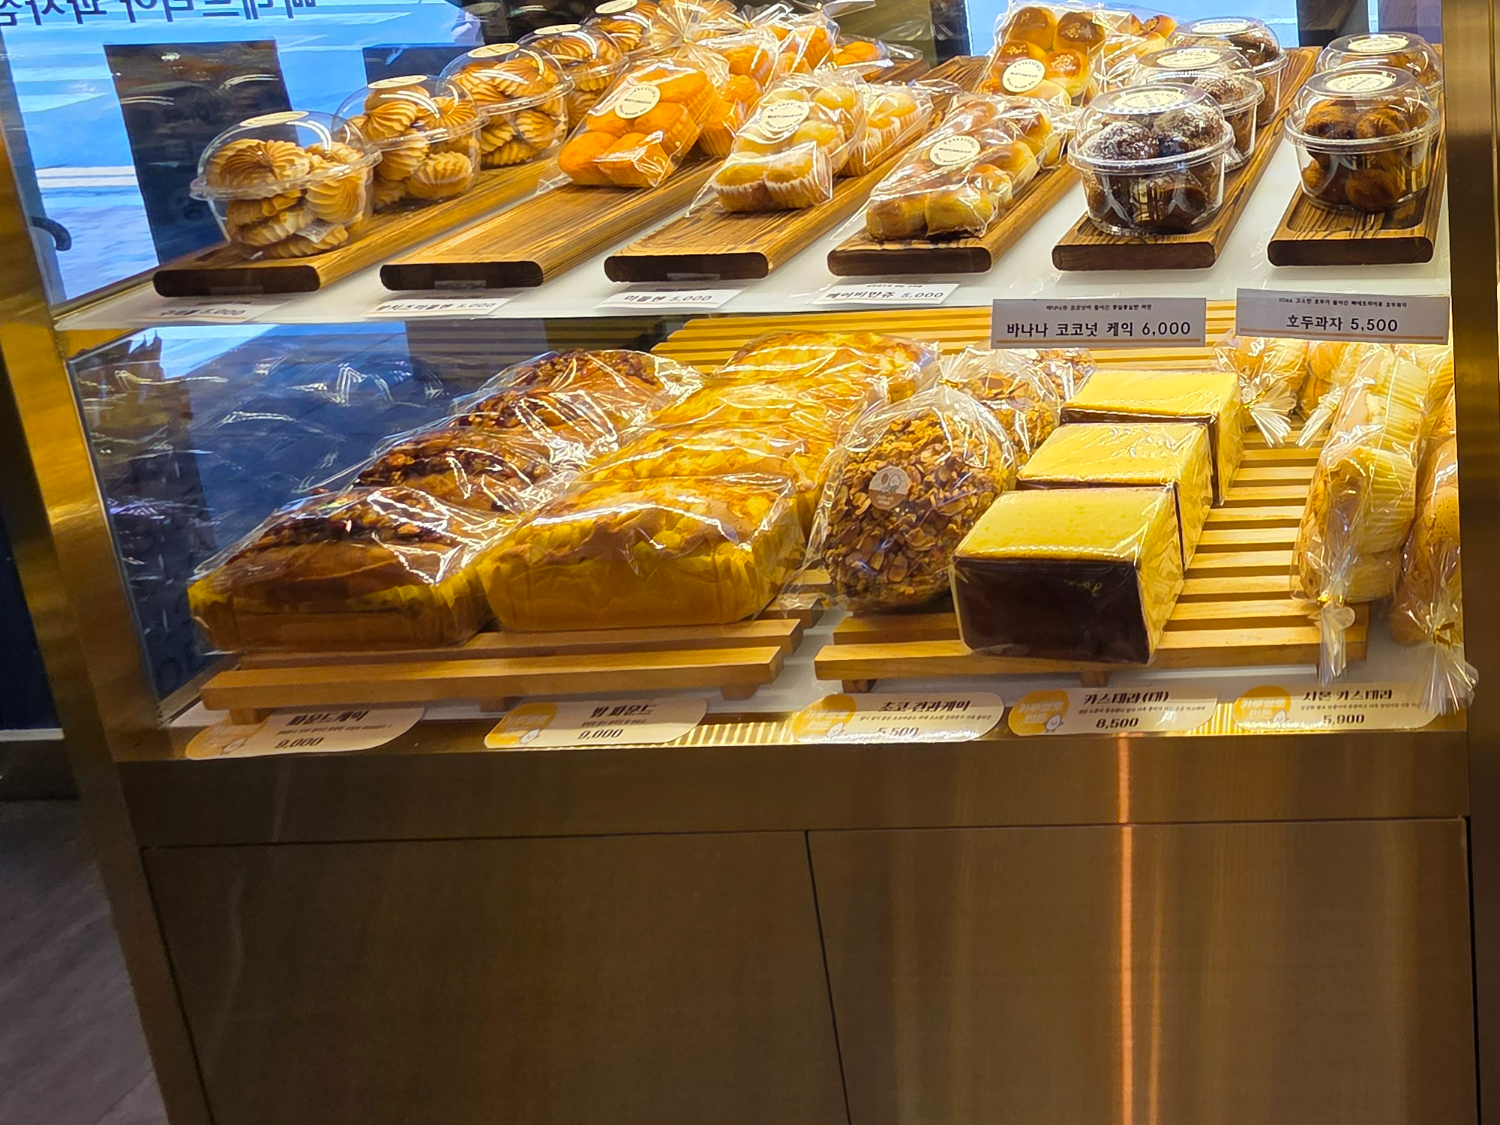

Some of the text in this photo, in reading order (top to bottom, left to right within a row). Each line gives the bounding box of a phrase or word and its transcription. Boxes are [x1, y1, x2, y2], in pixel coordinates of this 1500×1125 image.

[1007, 321, 1191, 338] 바나나 코코넛 케익 6,000
[1286, 314, 1398, 332] 호두과자 5,500
[1083, 691, 1170, 705] 카스테라(대)
[1336, 689, 1393, 702] 카스테라
[577, 728, 624, 740] 9,000
